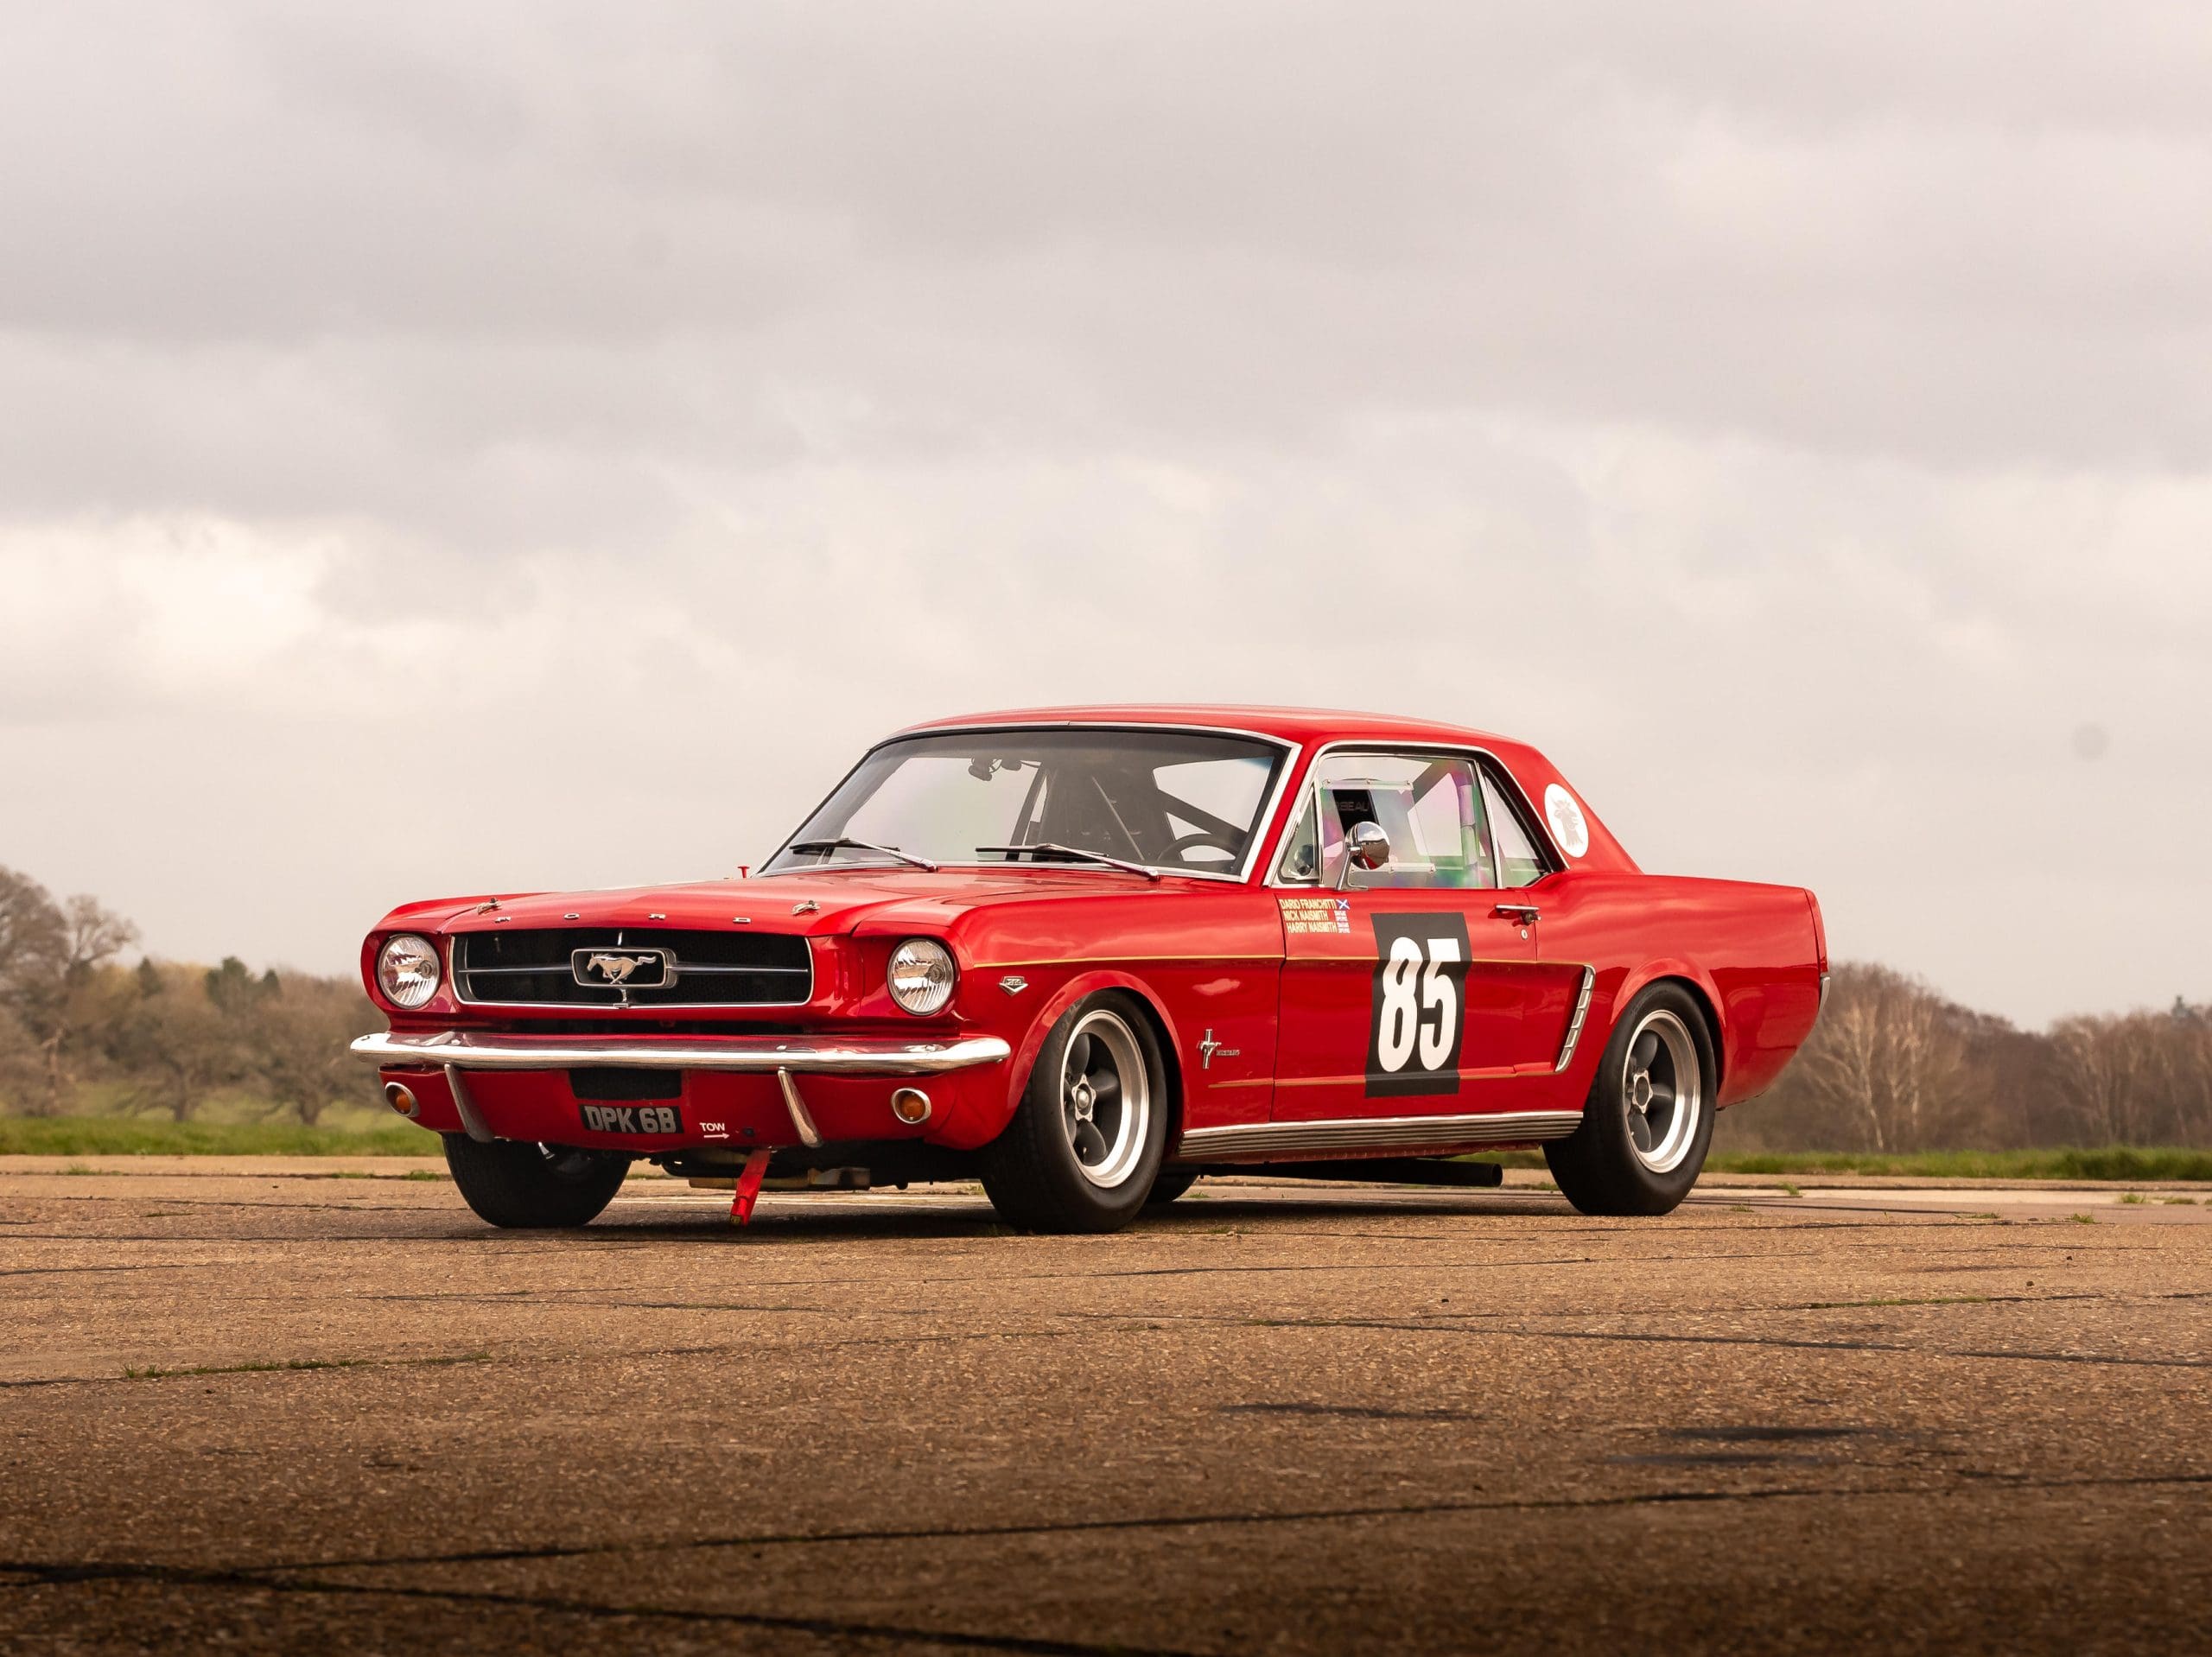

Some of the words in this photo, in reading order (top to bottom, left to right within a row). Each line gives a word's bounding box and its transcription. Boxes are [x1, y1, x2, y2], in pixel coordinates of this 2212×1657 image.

[1279, 898, 1300, 910] DARIO
[1283, 910, 1300, 921] NICK
[1286, 921, 1307, 933] HARRY
[1378, 936, 1461, 1072] 85
[584, 1106, 637, 1133] DPK
[639, 1107, 677, 1133] 6B
[699, 1122, 726, 1132] TOW
